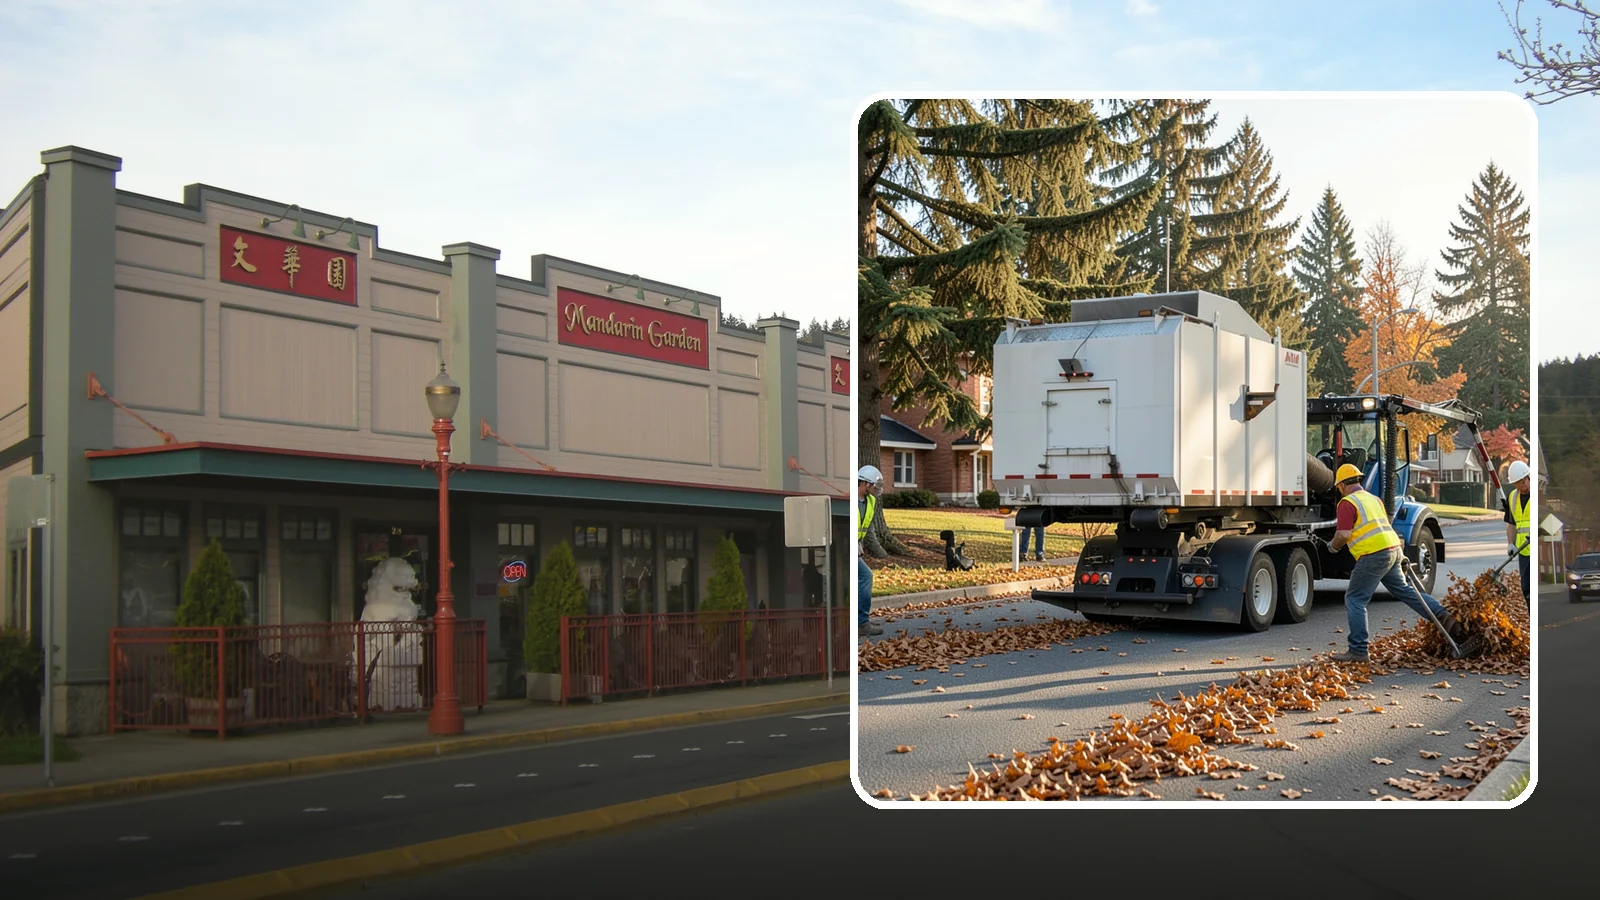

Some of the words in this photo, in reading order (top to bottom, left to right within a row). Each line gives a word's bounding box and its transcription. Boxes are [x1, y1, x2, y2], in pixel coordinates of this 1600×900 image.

[564, 302, 644, 341] Mandarin
[647, 320, 702, 352] Garden
[834, 363, 846, 386] 文
[503, 565, 527, 578] OPEN
